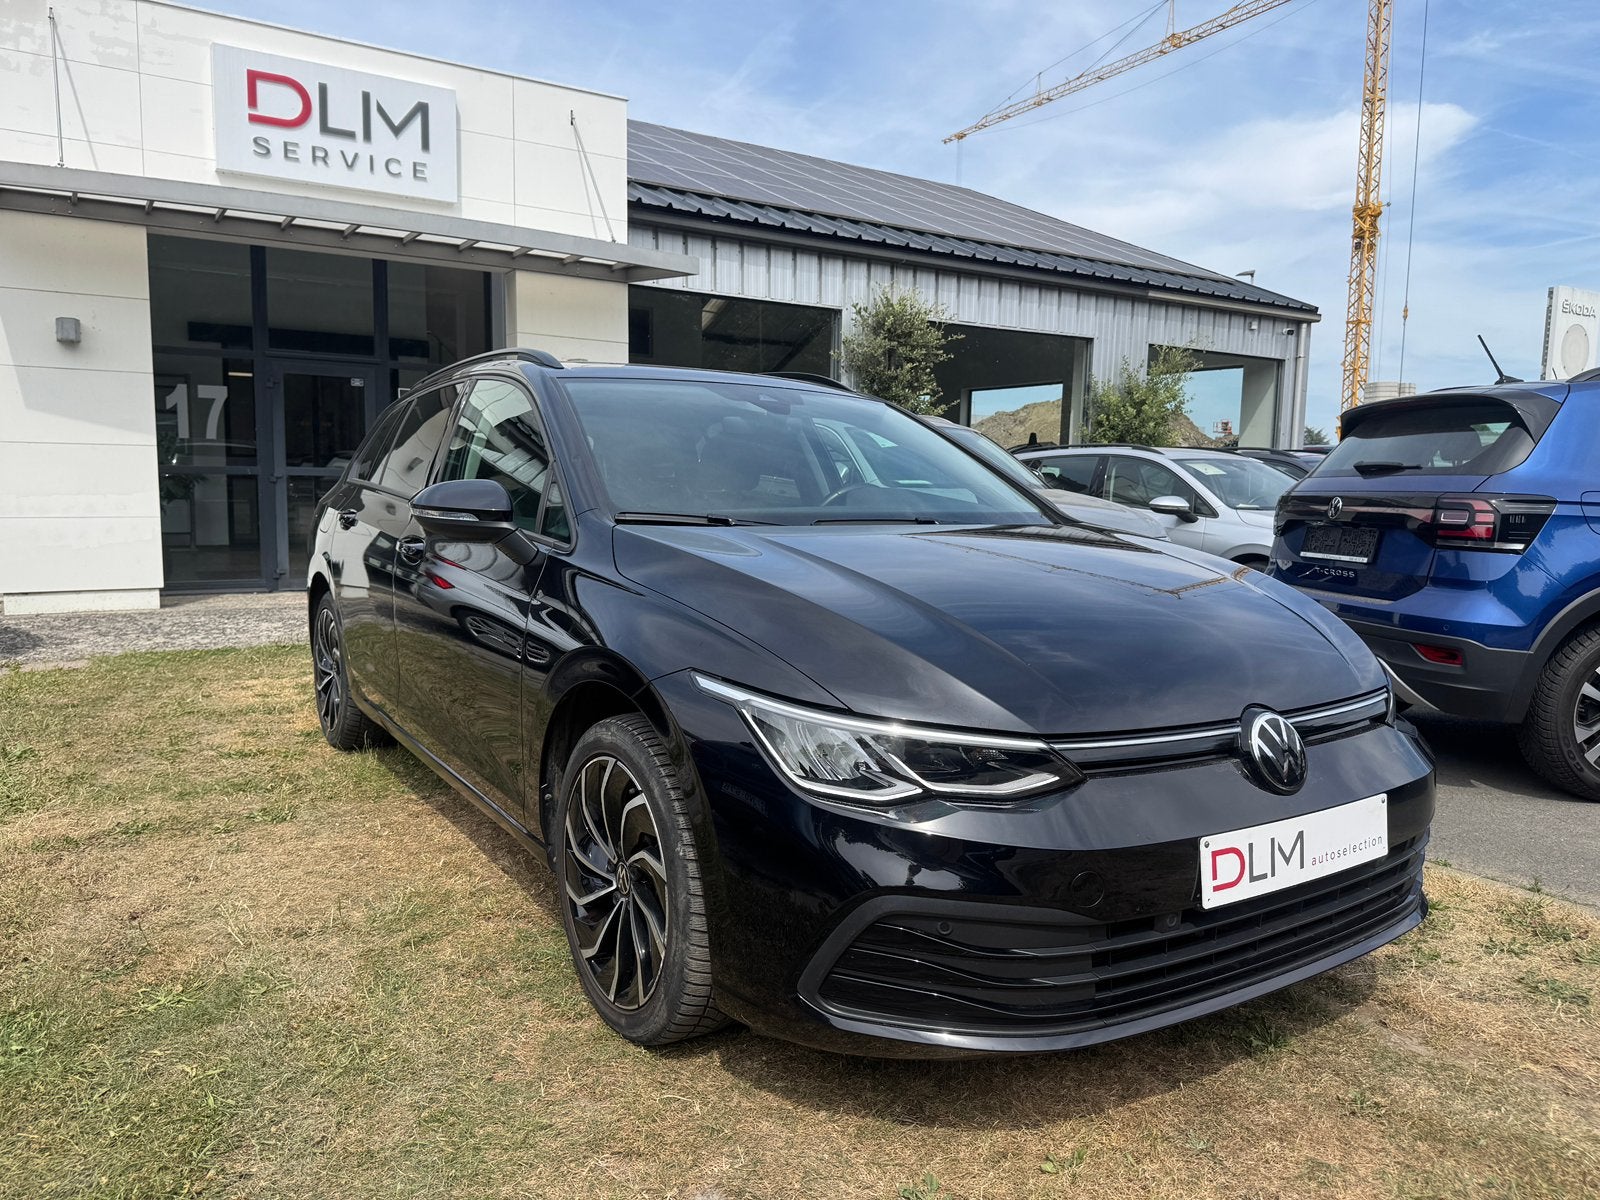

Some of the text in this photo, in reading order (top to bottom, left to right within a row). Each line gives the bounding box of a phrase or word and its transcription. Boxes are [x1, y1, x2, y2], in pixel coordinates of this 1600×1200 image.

[246, 68, 430, 151] DLM
[252, 136, 428, 181] SERVICE
[1561, 299, 1596, 318] ŠKODA
[165, 383, 228, 440] 17
[1211, 830, 1383, 893] DLM autoselection
